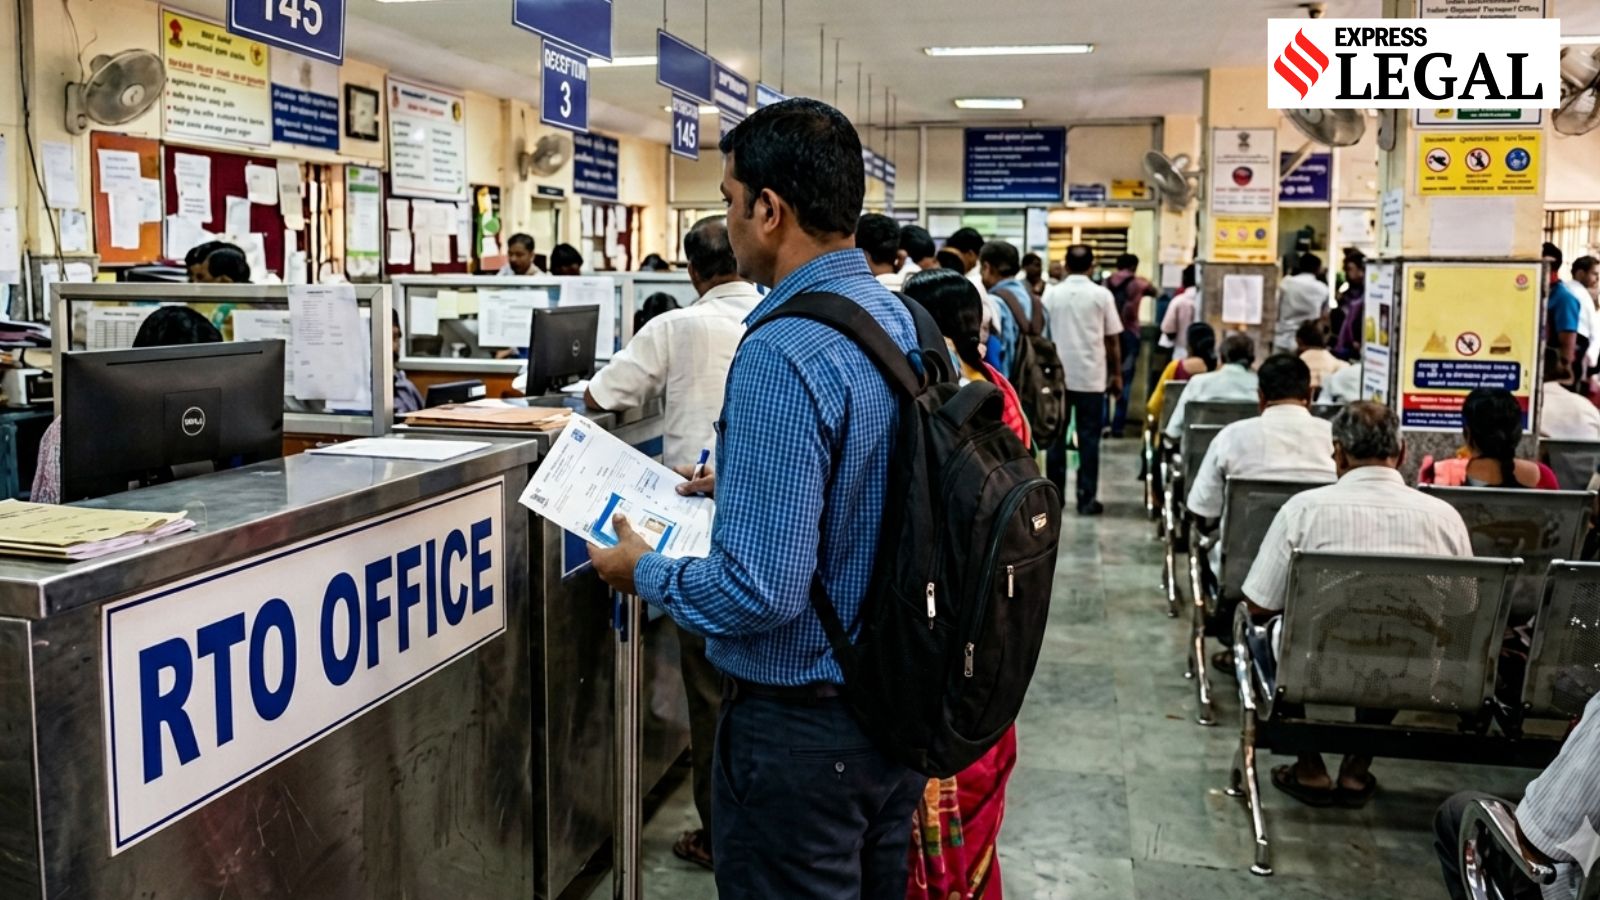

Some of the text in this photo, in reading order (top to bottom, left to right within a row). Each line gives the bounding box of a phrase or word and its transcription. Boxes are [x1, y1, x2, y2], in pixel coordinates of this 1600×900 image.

[559, 80, 572, 119] 3
[675, 118, 697, 149] 145
[139, 517, 494, 785] RTO OFFICE
